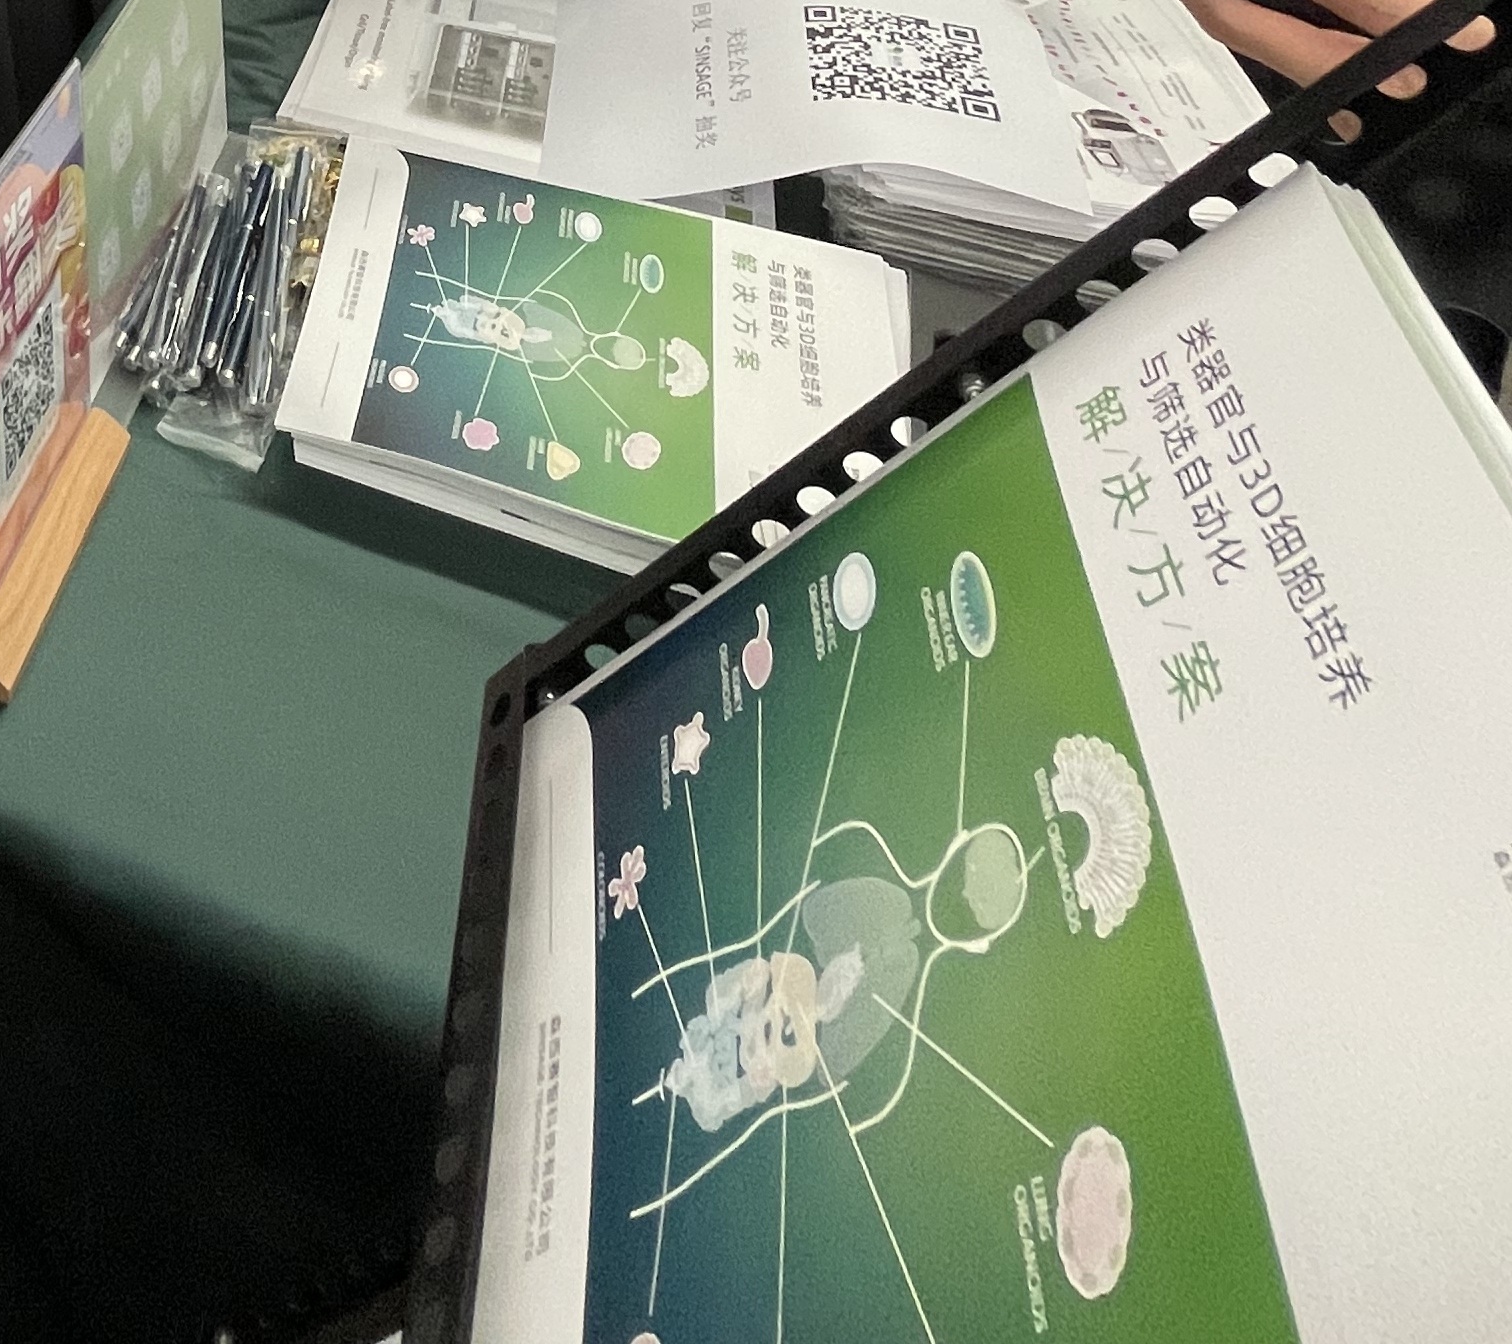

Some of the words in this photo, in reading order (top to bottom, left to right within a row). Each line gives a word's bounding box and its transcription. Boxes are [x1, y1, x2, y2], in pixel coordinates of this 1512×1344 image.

[727, 28, 752, 102] 关注公众号
[768, 261, 789, 349] 与筛选自动化
[793, 265, 823, 407] 类器官与3D细胞培养
[1139, 350, 1248, 586] 与筛选自动化
[1177, 317, 1372, 711] 类器官与3D细胞培养
